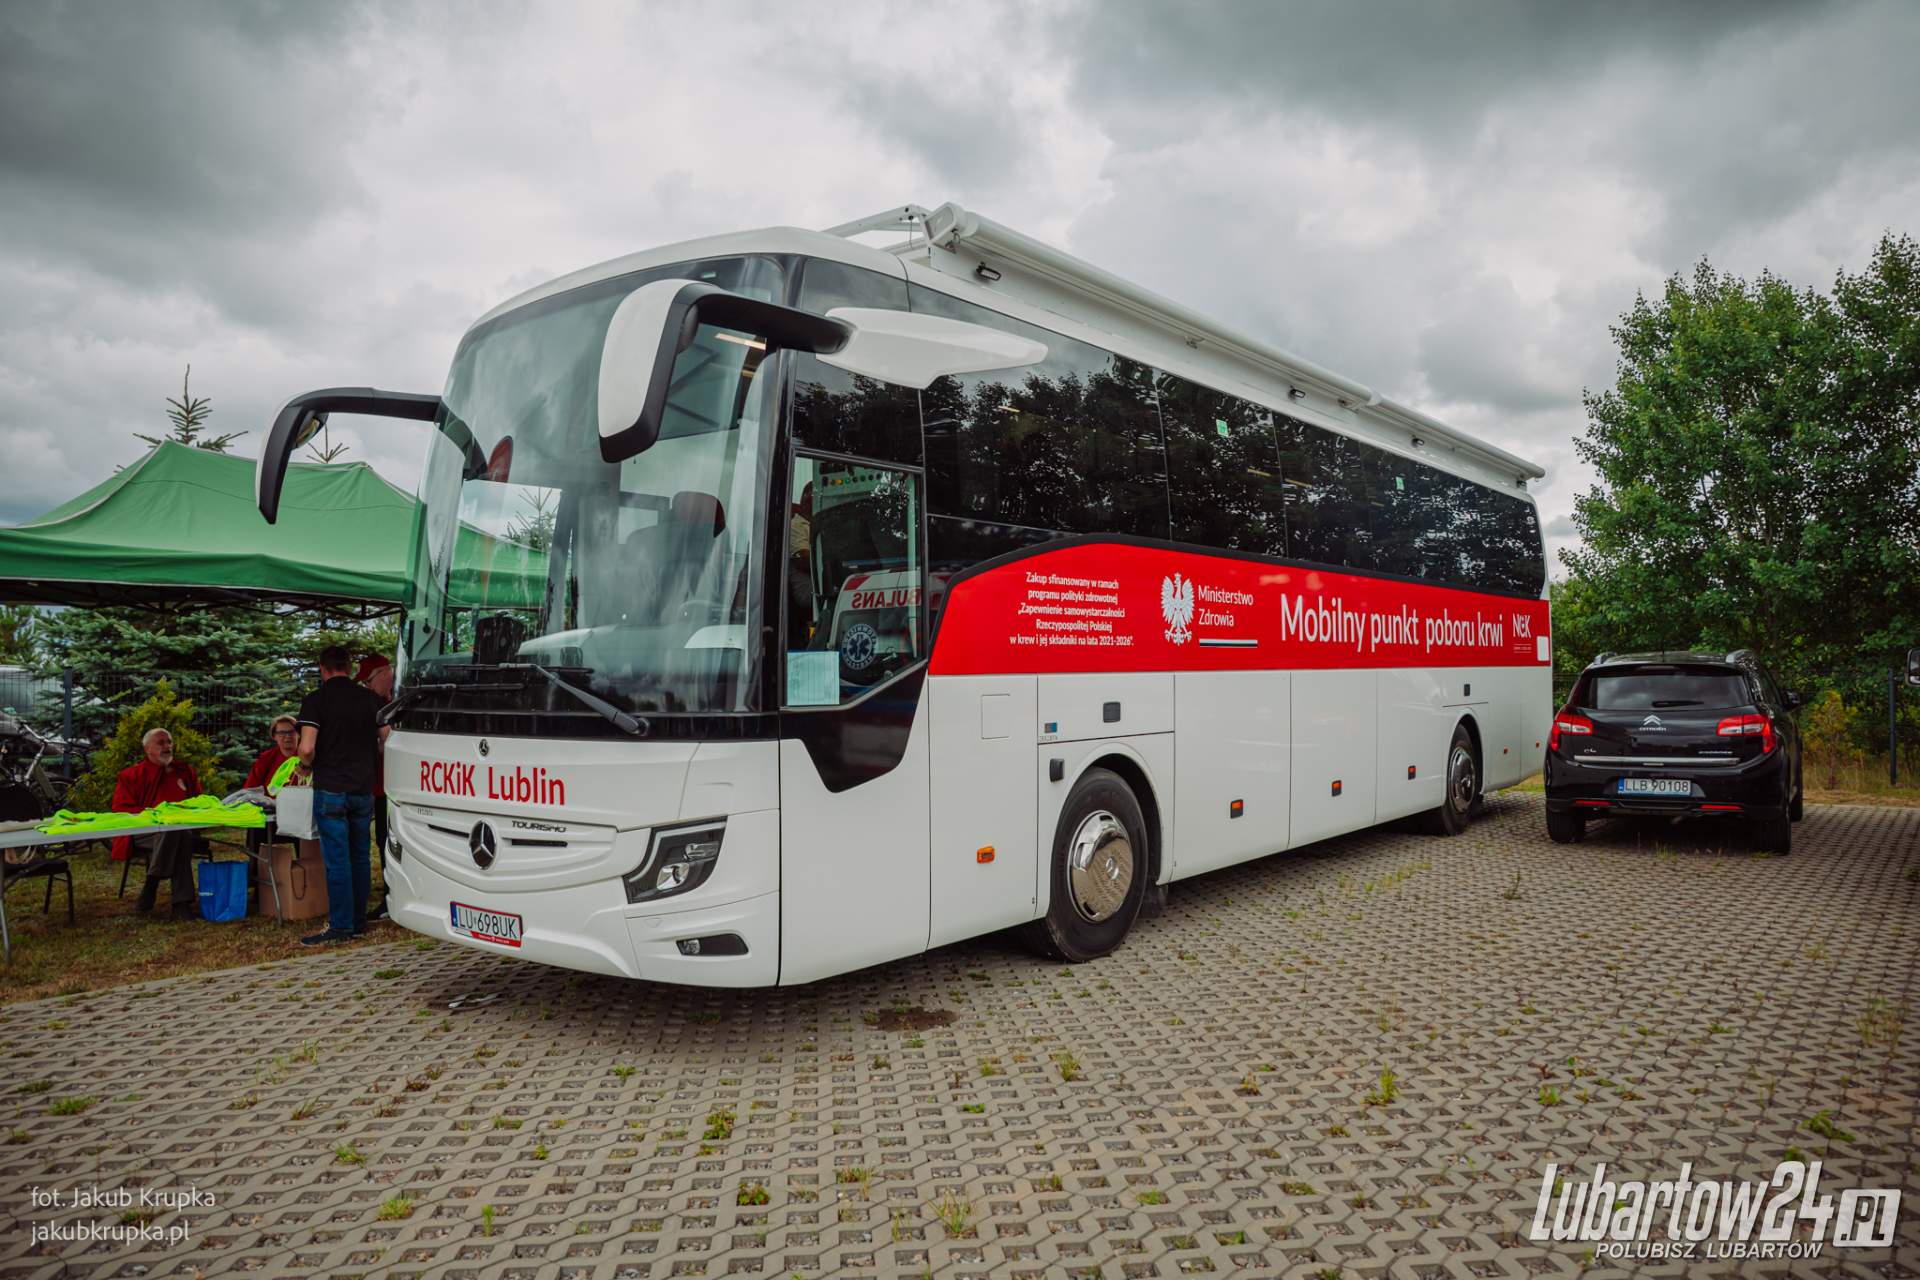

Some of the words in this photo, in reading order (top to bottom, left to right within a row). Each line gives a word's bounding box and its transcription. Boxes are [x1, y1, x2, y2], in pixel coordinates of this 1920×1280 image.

[1026, 571, 1047, 585] Zakup
[1048, 574, 1090, 589] sfinansowany
[1091, 579, 1097, 588] w
[1098, 579, 1119, 589] ramach
[1028, 590, 1060, 601] programu
[1061, 590, 1084, 603] polityki
[1085, 591, 1118, 605] zdrowotnej
[1198, 584, 1254, 606] Ministerstwo
[1064, 605, 1125, 618] samowystarczalności
[1198, 608, 1235, 627] Zdrowia
[1036, 619, 1088, 632] Rzeczypospolitej
[1090, 620, 1112, 633] Polskiej
[1280, 593, 1366, 653] Mobilny
[1370, 604, 1420, 653] punkt
[1425, 608, 1475, 653] poboru
[1477, 611, 1503, 648] krwi
[1010, 636, 1016, 645] w
[1018, 633, 1035, 645] krew
[1040, 633, 1048, 646] jej
[1049, 634, 1077, 645] składniki
[1078, 637, 1086, 645] na
[1087, 635, 1098, 645] lata
[420, 760, 476, 797] RCKiK
[488, 765, 565, 806] Lublin
[1625, 780, 1648, 791] LLB
[1651, 780, 1689, 792] 90108
[512, 820, 568, 833] TOURISMO
[458, 907, 473, 929] LU
[477, 912, 518, 940] 698UK
